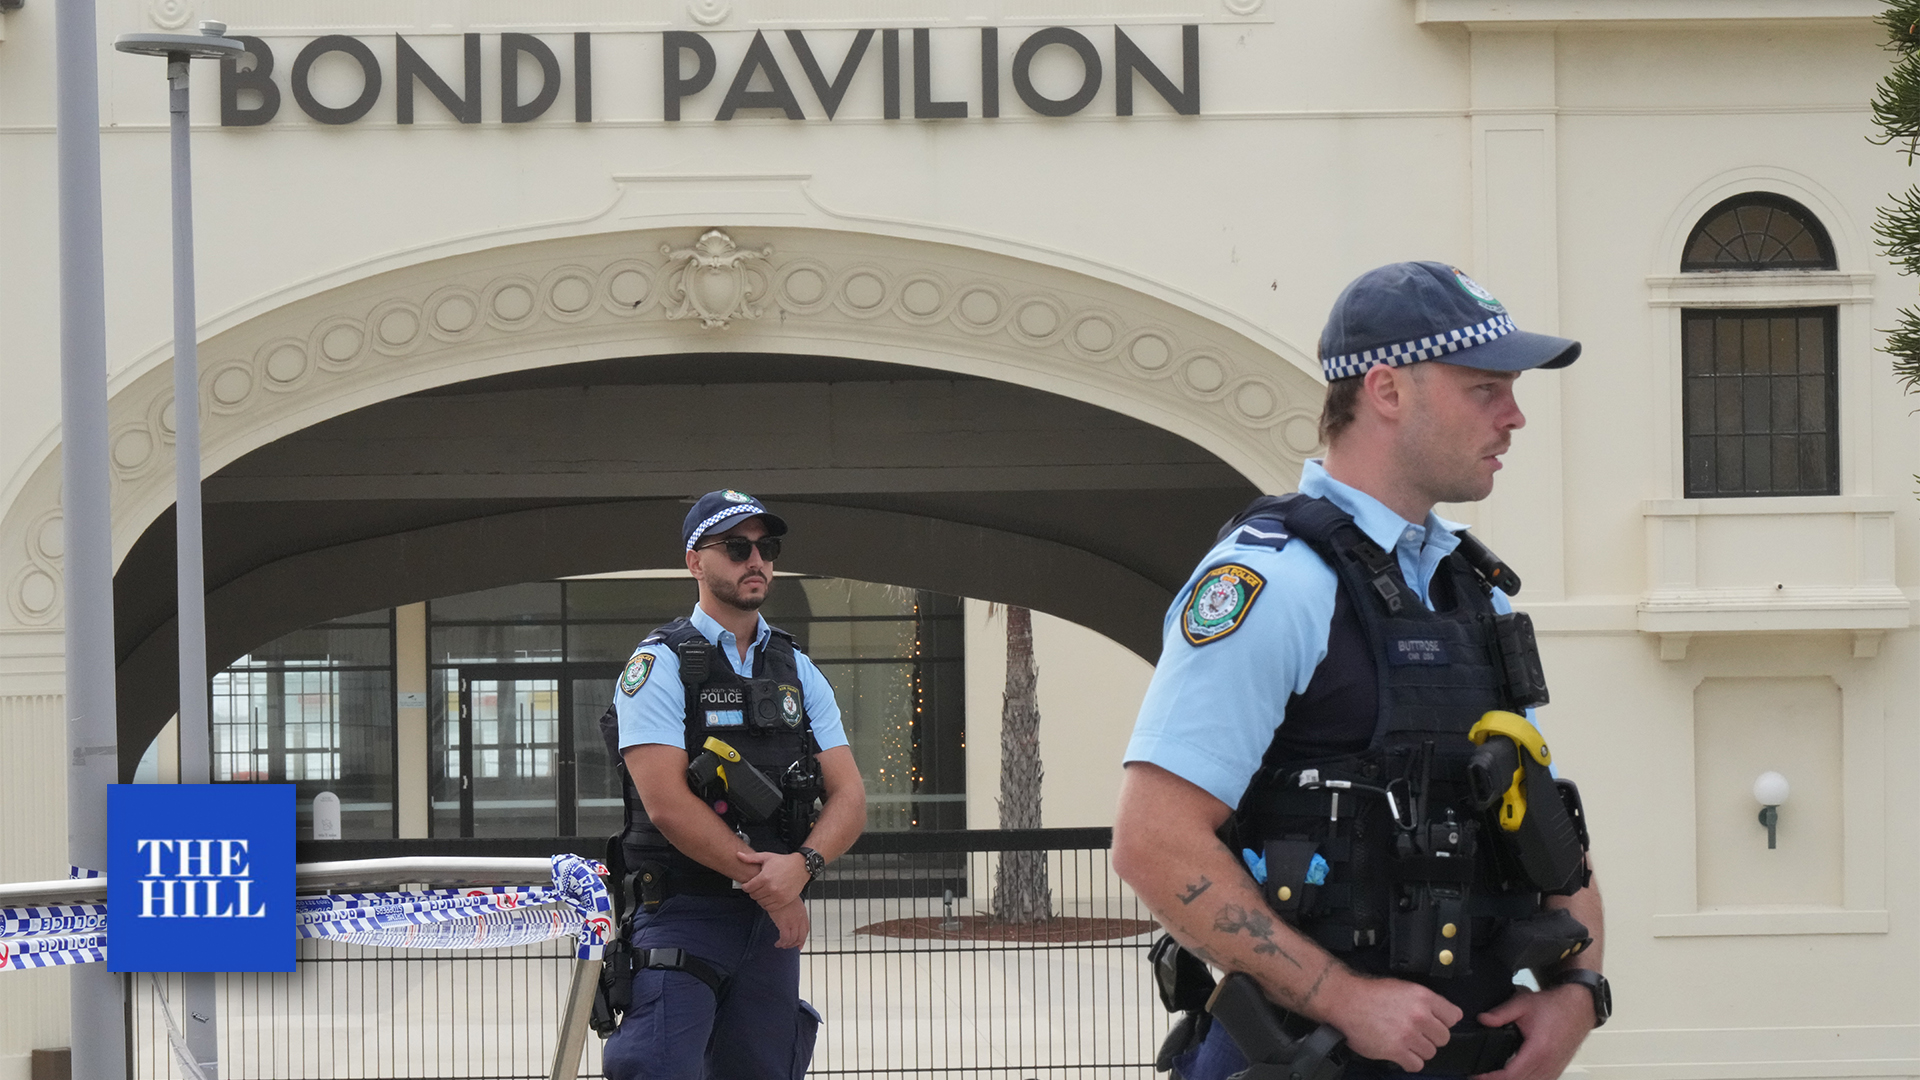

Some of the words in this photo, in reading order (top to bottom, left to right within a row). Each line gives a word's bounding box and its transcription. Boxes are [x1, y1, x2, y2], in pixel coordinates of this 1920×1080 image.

[219, 31, 592, 127] BONDI
[663, 24, 1201, 122] PAVILION
[1398, 640, 1440, 652] BUTTROSE
[700, 693, 743, 703] POLICE
[375, 904, 403, 916] STOPPERS
[431, 897, 480, 910] POLICE
[41, 916, 107, 930] POLICE
[304, 909, 356, 924] POLICE
[386, 913, 405, 921] CRIME
[40, 937, 96, 952] POLICE
